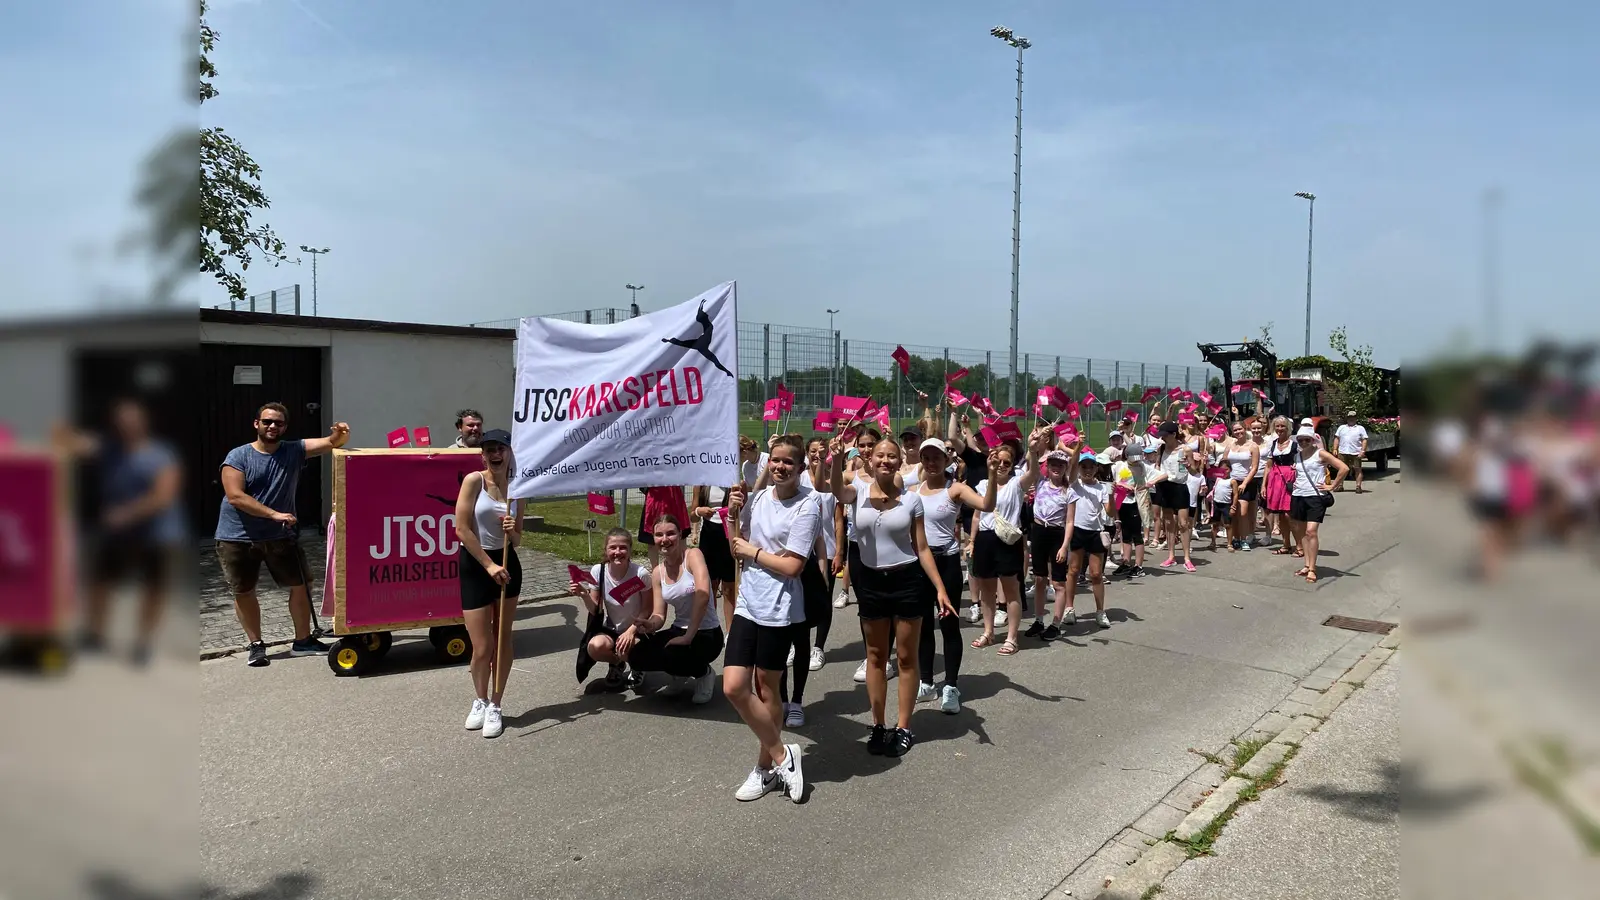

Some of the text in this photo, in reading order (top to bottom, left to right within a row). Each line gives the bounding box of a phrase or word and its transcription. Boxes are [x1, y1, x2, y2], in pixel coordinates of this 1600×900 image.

[563, 415, 676, 445] FIND YOUR RHYTHM
[509, 452, 738, 478] 1. Karlsfelder Jugend Tanz Sport Club e.V.
[369, 513, 459, 560] JTSC
[586, 520, 597, 529] 40
[369, 560, 459, 586] KARLSFELD
